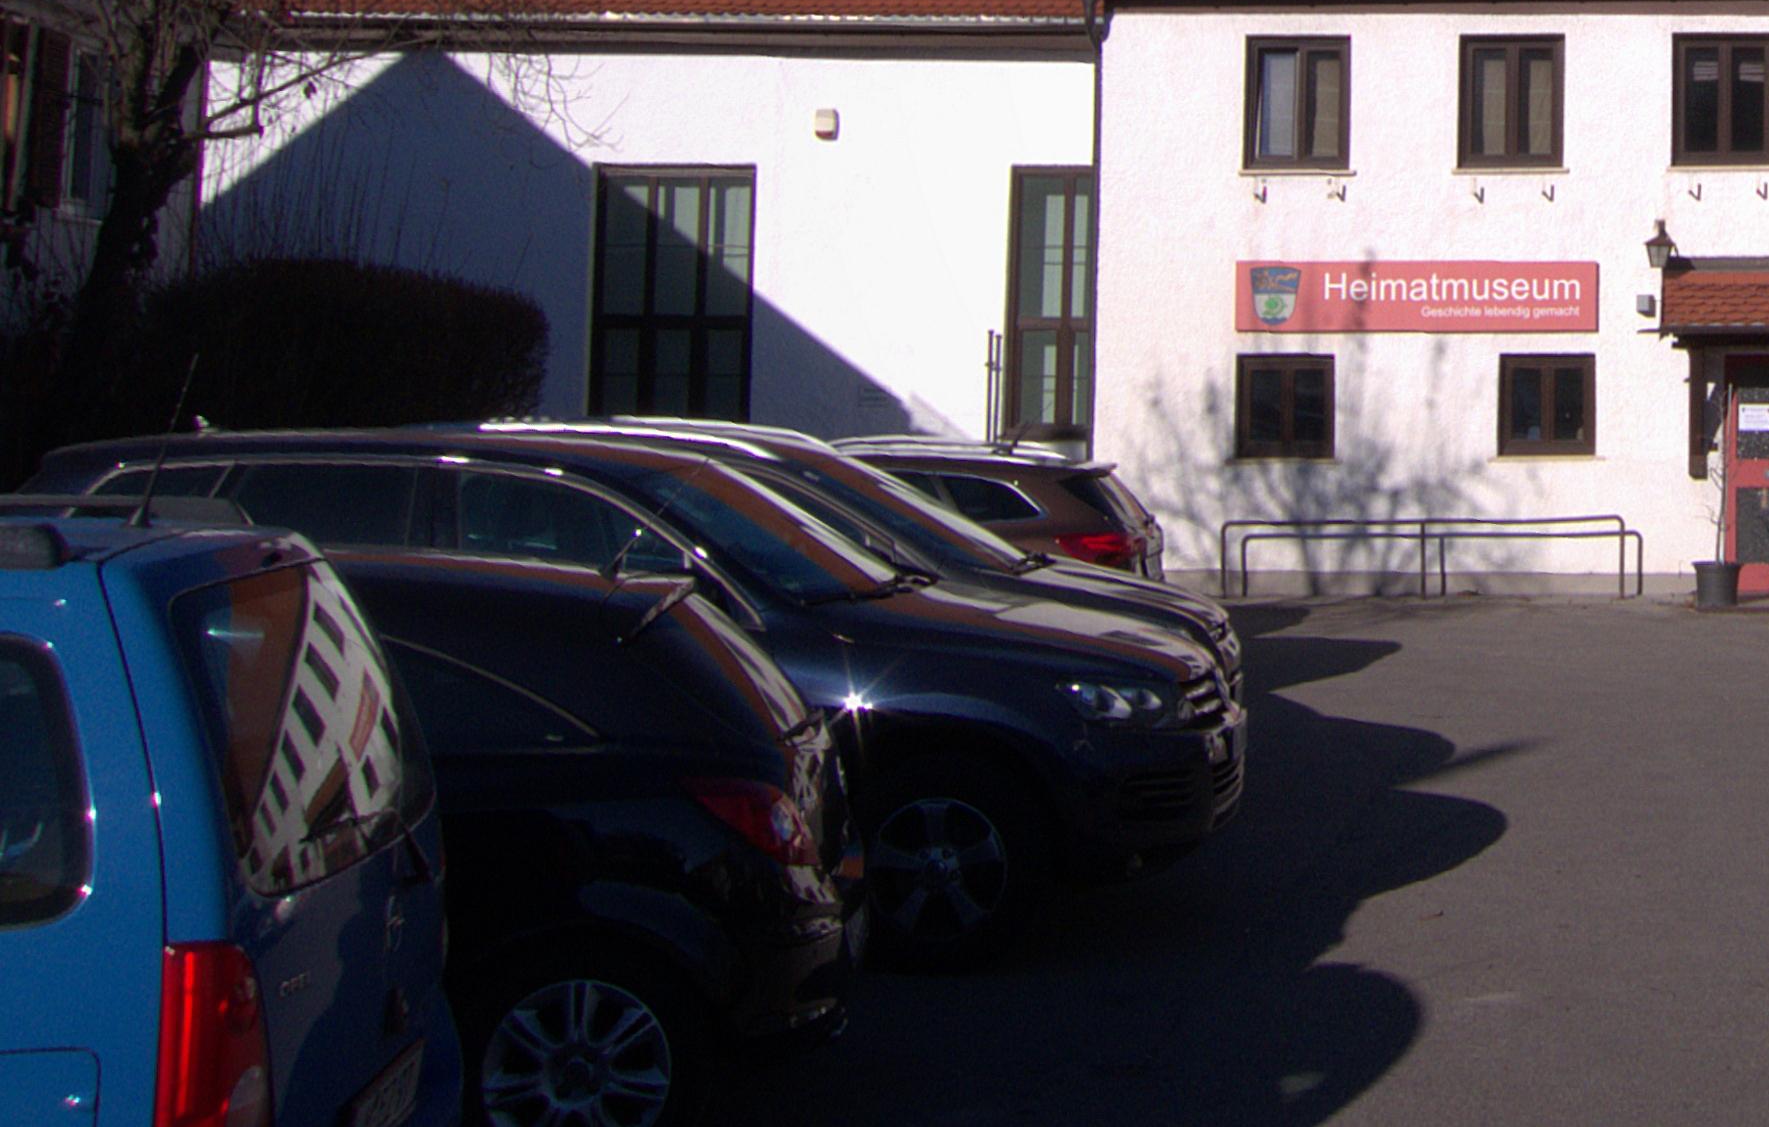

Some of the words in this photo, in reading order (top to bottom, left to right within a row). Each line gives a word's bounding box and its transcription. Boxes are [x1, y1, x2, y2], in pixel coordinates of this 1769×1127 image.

[1323, 272, 1582, 302] Heimatmuseum
[1420, 305, 1482, 319] Geschichte
[1484, 305, 1531, 319] lebendig
[1532, 305, 1580, 319] gemacht
